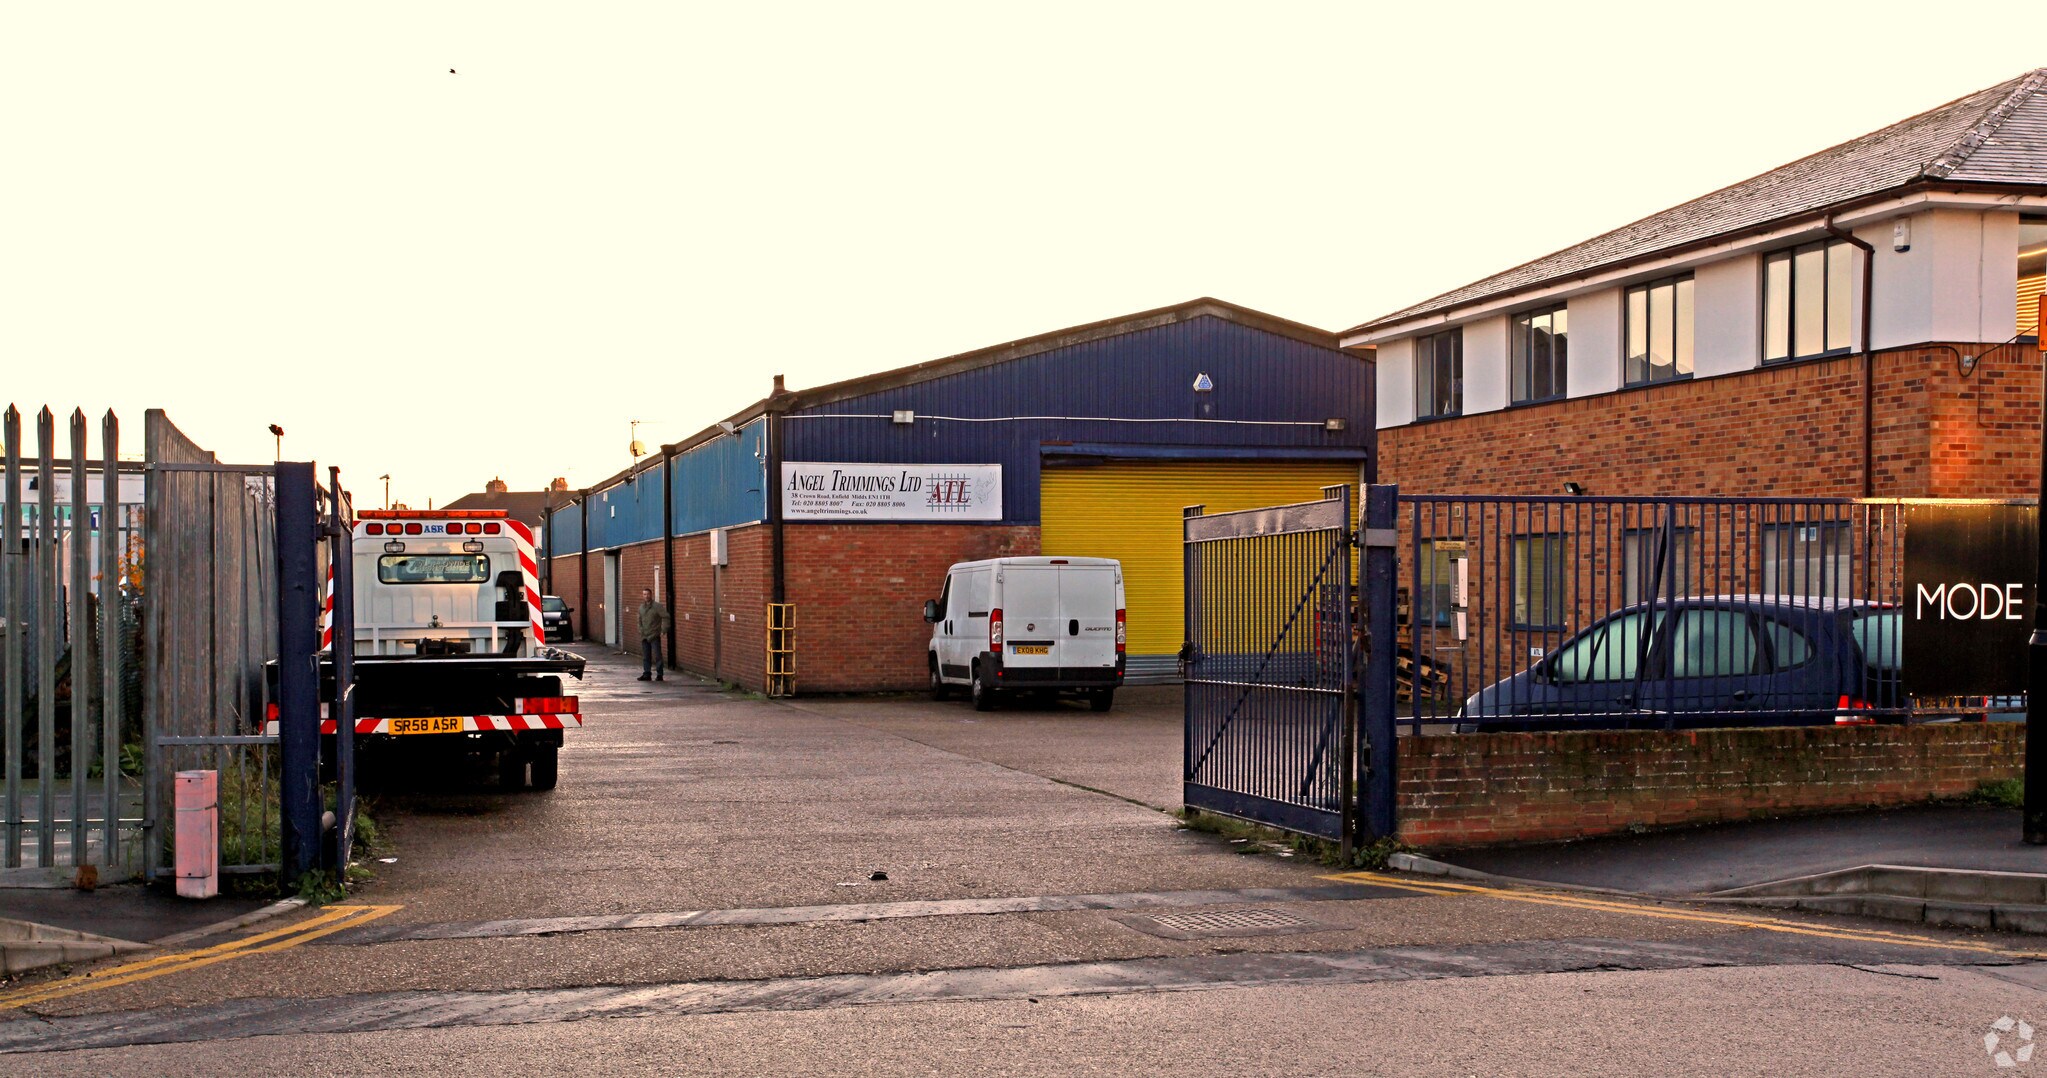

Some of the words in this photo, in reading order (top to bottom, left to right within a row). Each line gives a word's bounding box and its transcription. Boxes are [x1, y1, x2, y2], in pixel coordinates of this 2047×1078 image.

[787, 469, 825, 491] ANGEL
[831, 469, 896, 492] TRIMMINGS
[927, 481, 970, 503] ATL
[424, 525, 444, 533] ASR
[1917, 583, 2023, 620] MODE
[394, 720, 428, 732] SR58
[433, 718, 458, 730] ASR
